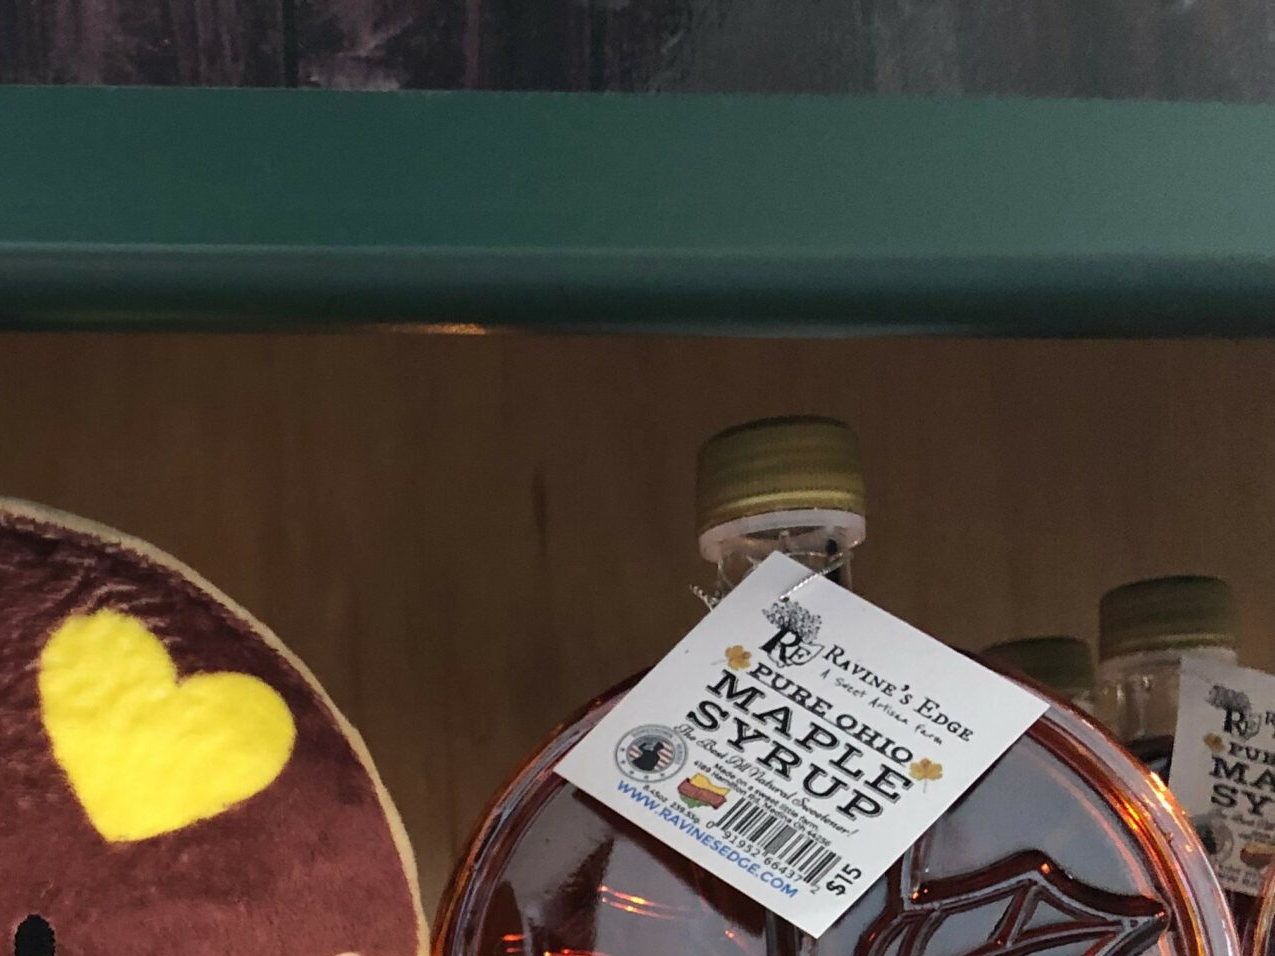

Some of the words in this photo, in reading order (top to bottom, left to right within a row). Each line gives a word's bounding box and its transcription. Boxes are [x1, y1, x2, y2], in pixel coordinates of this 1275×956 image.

[707, 669, 911, 802] MAPLE
[749, 663, 832, 718] PURE
[832, 713, 912, 765] OHIO
[822, 644, 912, 704] RAVINE'S
[913, 697, 973, 741] EDGE
[671, 723, 696, 740] The
[696, 739, 727, 759] Best
[724, 755, 752, 772] All
[749, 764, 797, 802] Natural
[791, 792, 858, 835] Sweetener!
[686, 700, 883, 821] SYRUP
[617, 780, 797, 897] WWW.RAVINESEDGE.COM
[705, 820, 716, 828] 0
[721, 828, 760, 857] 91952
[763, 854, 803, 881] 66437
[809, 883, 820, 894] 2
[825, 862, 861, 896] $15
